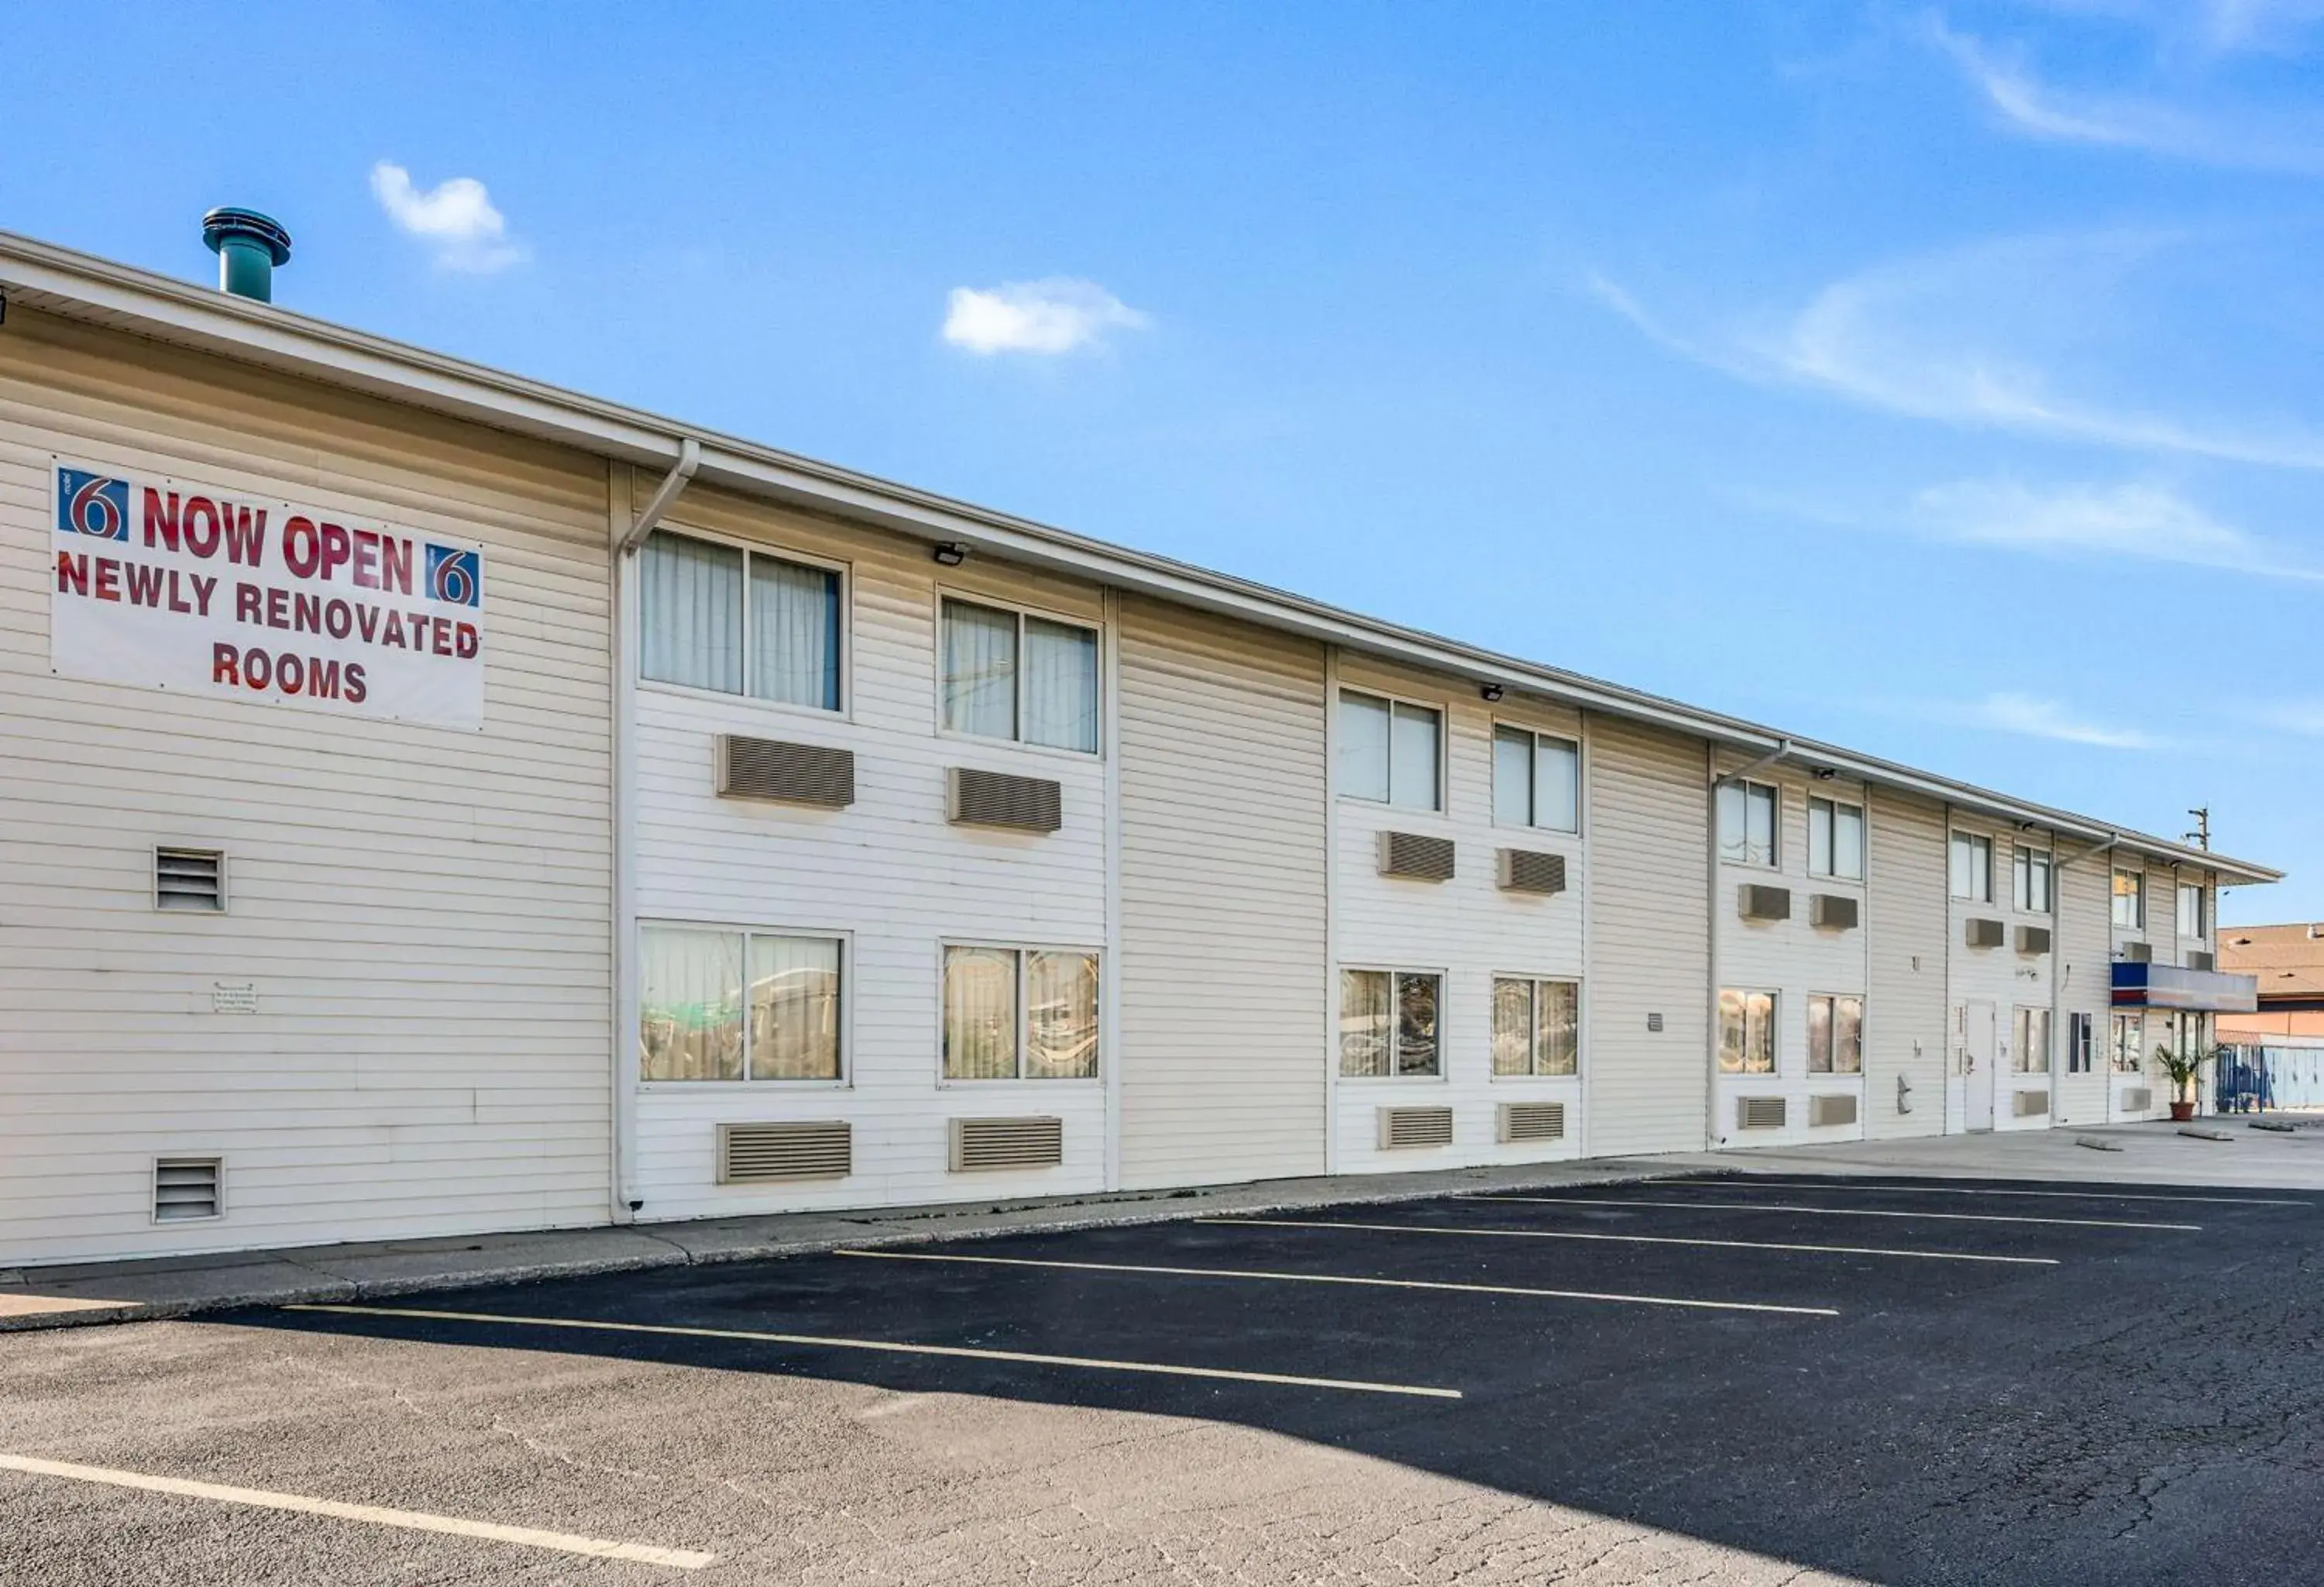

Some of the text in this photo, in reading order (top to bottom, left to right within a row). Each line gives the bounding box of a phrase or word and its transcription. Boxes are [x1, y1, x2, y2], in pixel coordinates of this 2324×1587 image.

[70, 477, 122, 539] 6
[143, 486, 414, 595] NOW OPEN
[57, 550, 479, 659] NEWLY RENOVATED
[435, 551, 474, 606] 6
[212, 642, 366, 704] ROOMS
